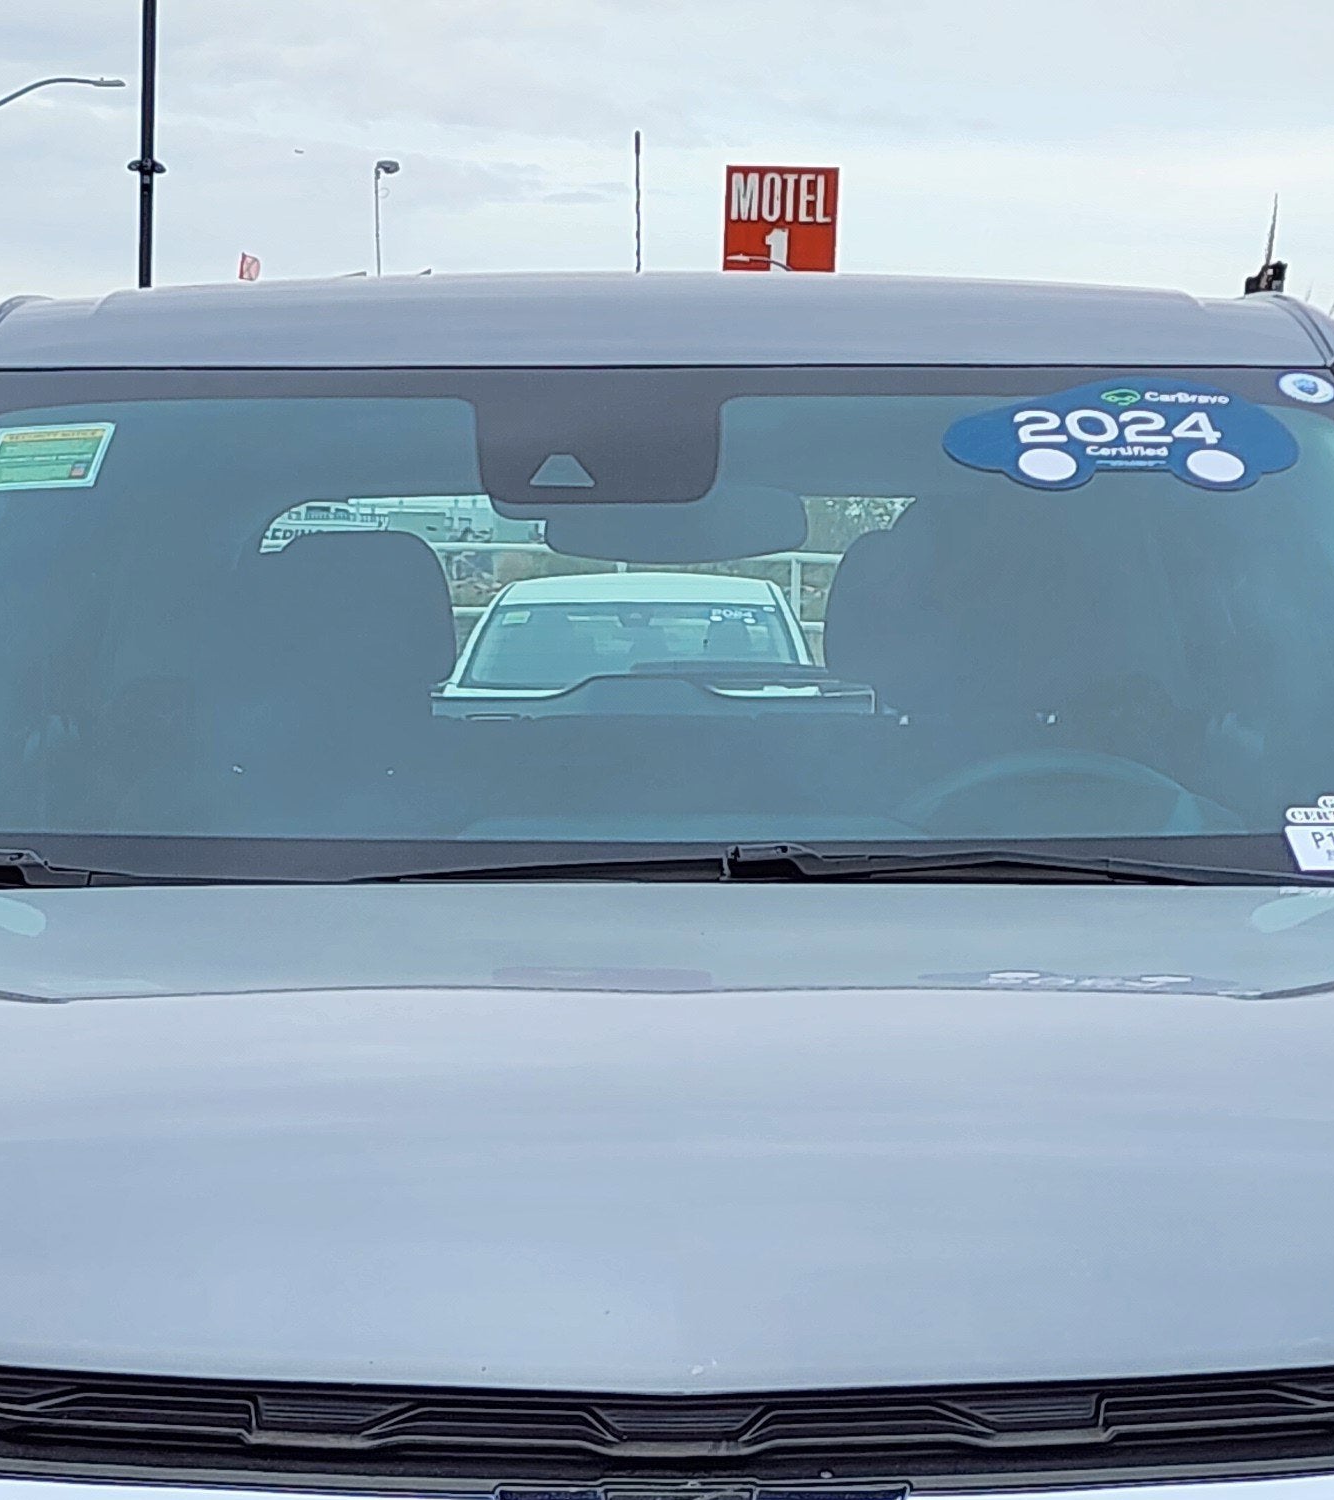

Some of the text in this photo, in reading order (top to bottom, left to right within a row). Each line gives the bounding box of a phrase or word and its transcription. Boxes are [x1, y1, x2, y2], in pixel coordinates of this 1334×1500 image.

[731, 172, 832, 223] MOTEL
[765, 228, 789, 271] 1
[1013, 408, 1222, 445] 2024
[1085, 445, 1169, 457] Certified
